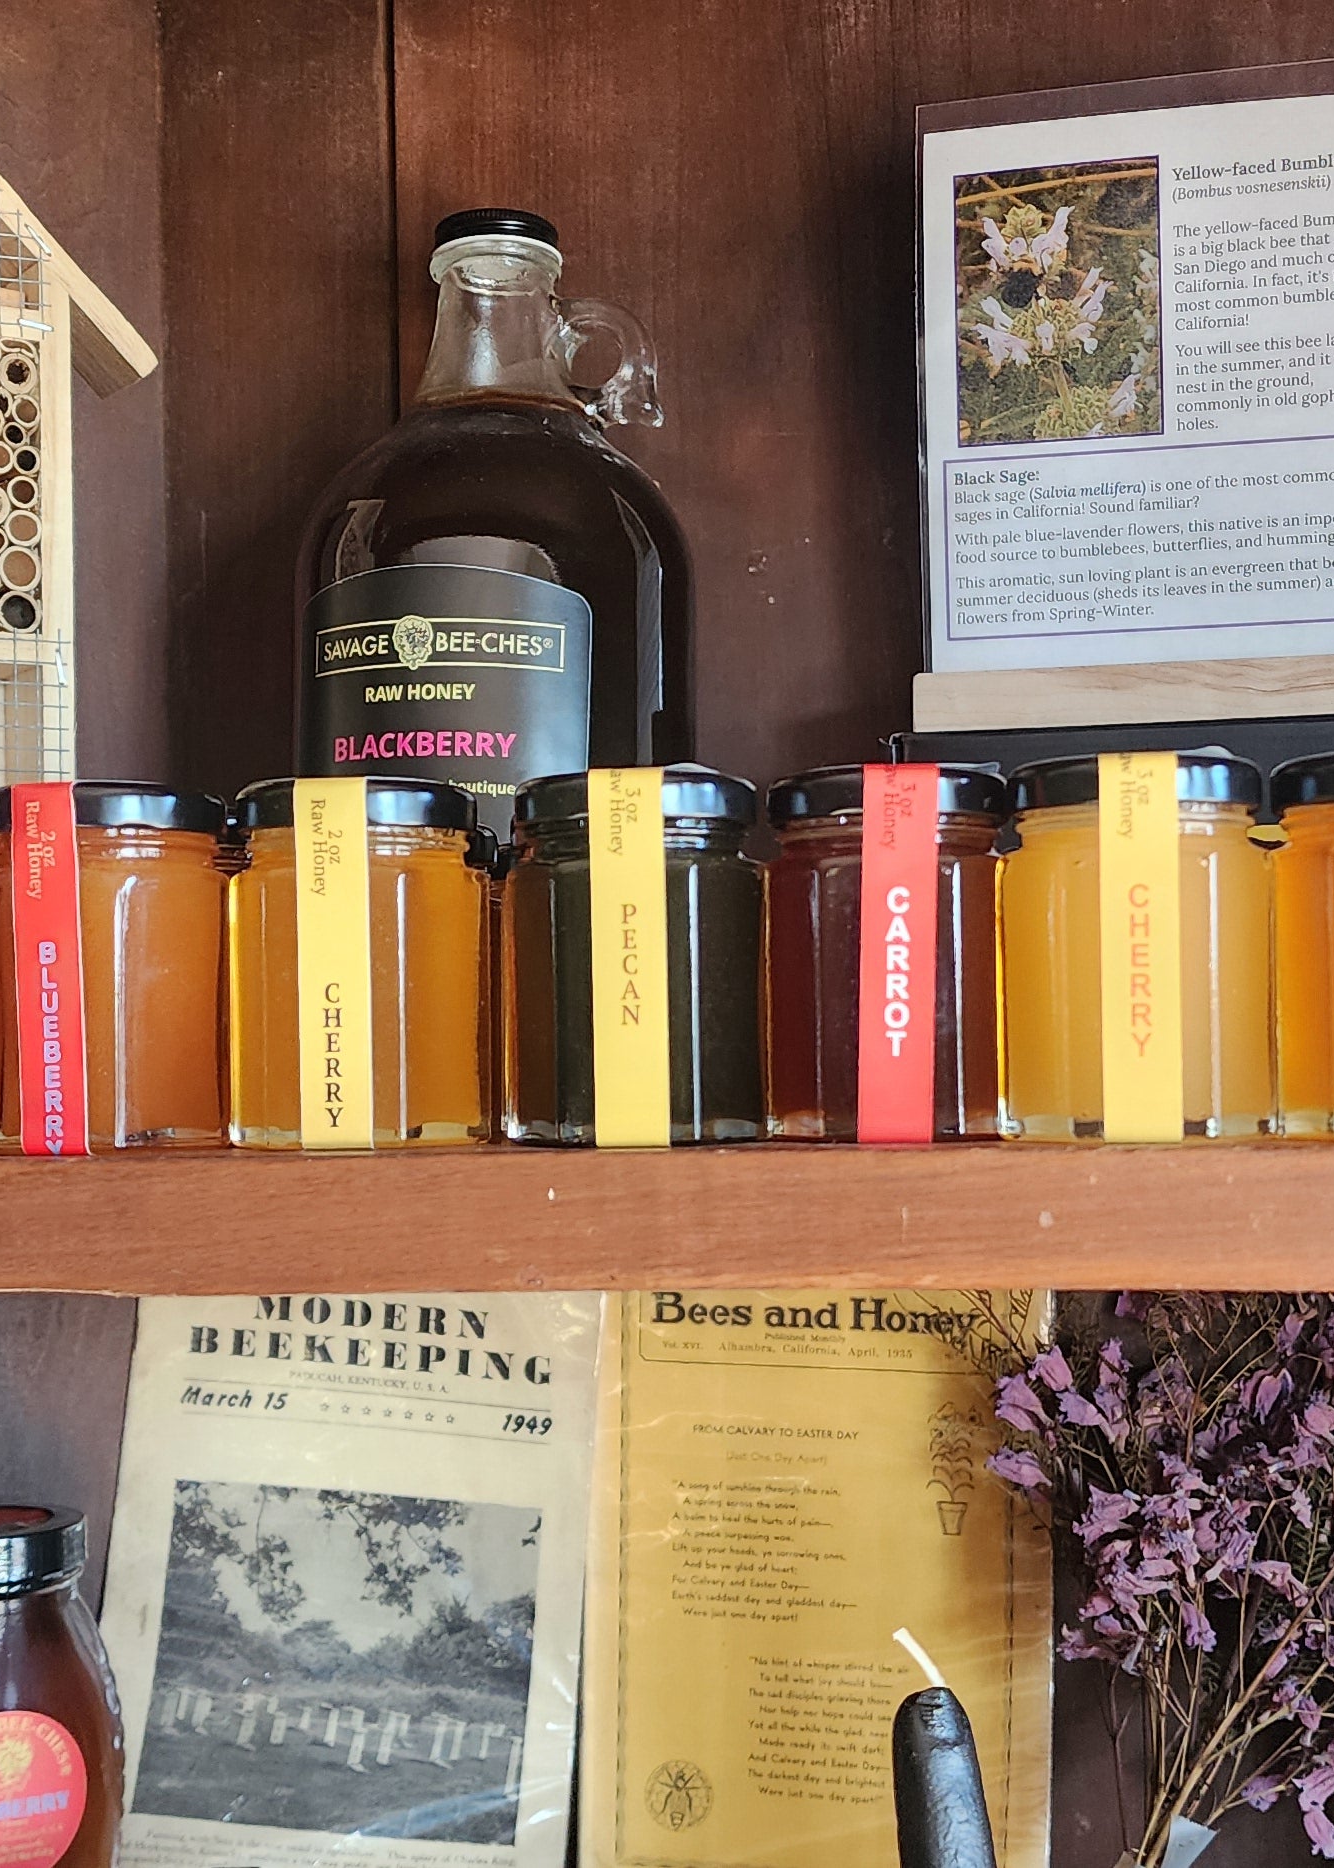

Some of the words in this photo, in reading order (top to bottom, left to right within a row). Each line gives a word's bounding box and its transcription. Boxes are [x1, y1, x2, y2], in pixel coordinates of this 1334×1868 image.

[1172, 158, 1276, 181] Yellow-faced
[1172, 184, 1232, 204] (Bombus
[1236, 175, 1331, 195] vosnesenskii)
[1173, 224, 1200, 238] The
[1205, 215, 1298, 239] yellow-faced
[1174, 263, 1200, 275] San
[1205, 259, 1246, 275] Diego
[1251, 254, 1277, 269] and
[1282, 251, 1323, 266] much
[1175, 300, 1211, 312] most
[1215, 296, 1279, 309] common
[1177, 396, 1252, 412] commonly
[1257, 395, 1270, 407] in
[1275, 392, 1297, 406] old
[954, 471, 995, 485] Black
[1000, 470, 1039, 486] Sage:
[955, 490, 990, 504] Black
[995, 491, 1025, 505] sage
[1030, 485, 1076, 503] (Salvia
[1080, 480, 1146, 498] mellifera)
[1151, 480, 1161, 492] is
[1166, 481, 1192, 491] one
[1197, 476, 1212, 489] of
[1215, 475, 1238, 488] the
[1243, 474, 1279, 486] most
[958, 612, 1008, 624] flowers
[1012, 609, 1045, 622] from
[1050, 605, 1154, 623] Spring-Winter.
[324, 635, 389, 662] SAVAGE
[365, 684, 402, 702] RAW
[407, 683, 475, 701] HONEY
[334, 731, 517, 762] BLACKBERRY
[26, 801, 40, 839] Raw
[310, 799, 326, 835] Raw
[607, 799, 625, 856] Honey
[40, 830, 56, 842] 2
[328, 830, 343, 839] 2
[42, 846, 56, 867] oz
[310, 841, 328, 896] Honey
[328, 845, 341, 865] oz
[27, 843, 43, 900] Honey
[620, 903, 641, 1026] PECAN
[885, 886, 911, 1057] CARROT
[1127, 883, 1153, 1058] CHERRY
[38, 941, 63, 1155] BLUEBERRY
[323, 982, 345, 1128] CHERRY
[253, 1296, 489, 1339] MODERN
[651, 1291, 752, 1326] Bees
[764, 1303, 840, 1330] and
[187, 1325, 552, 1386] BEEKEEPING
[180, 1385, 253, 1409] March
[264, 1392, 289, 1410] 15
[501, 1413, 553, 1436] 1949
[727, 1426, 776, 1436] CALVARY
[779, 1427, 793, 1437] TO
[797, 1429, 832, 1439] EASTER
[837, 1430, 859, 1440] DAY
